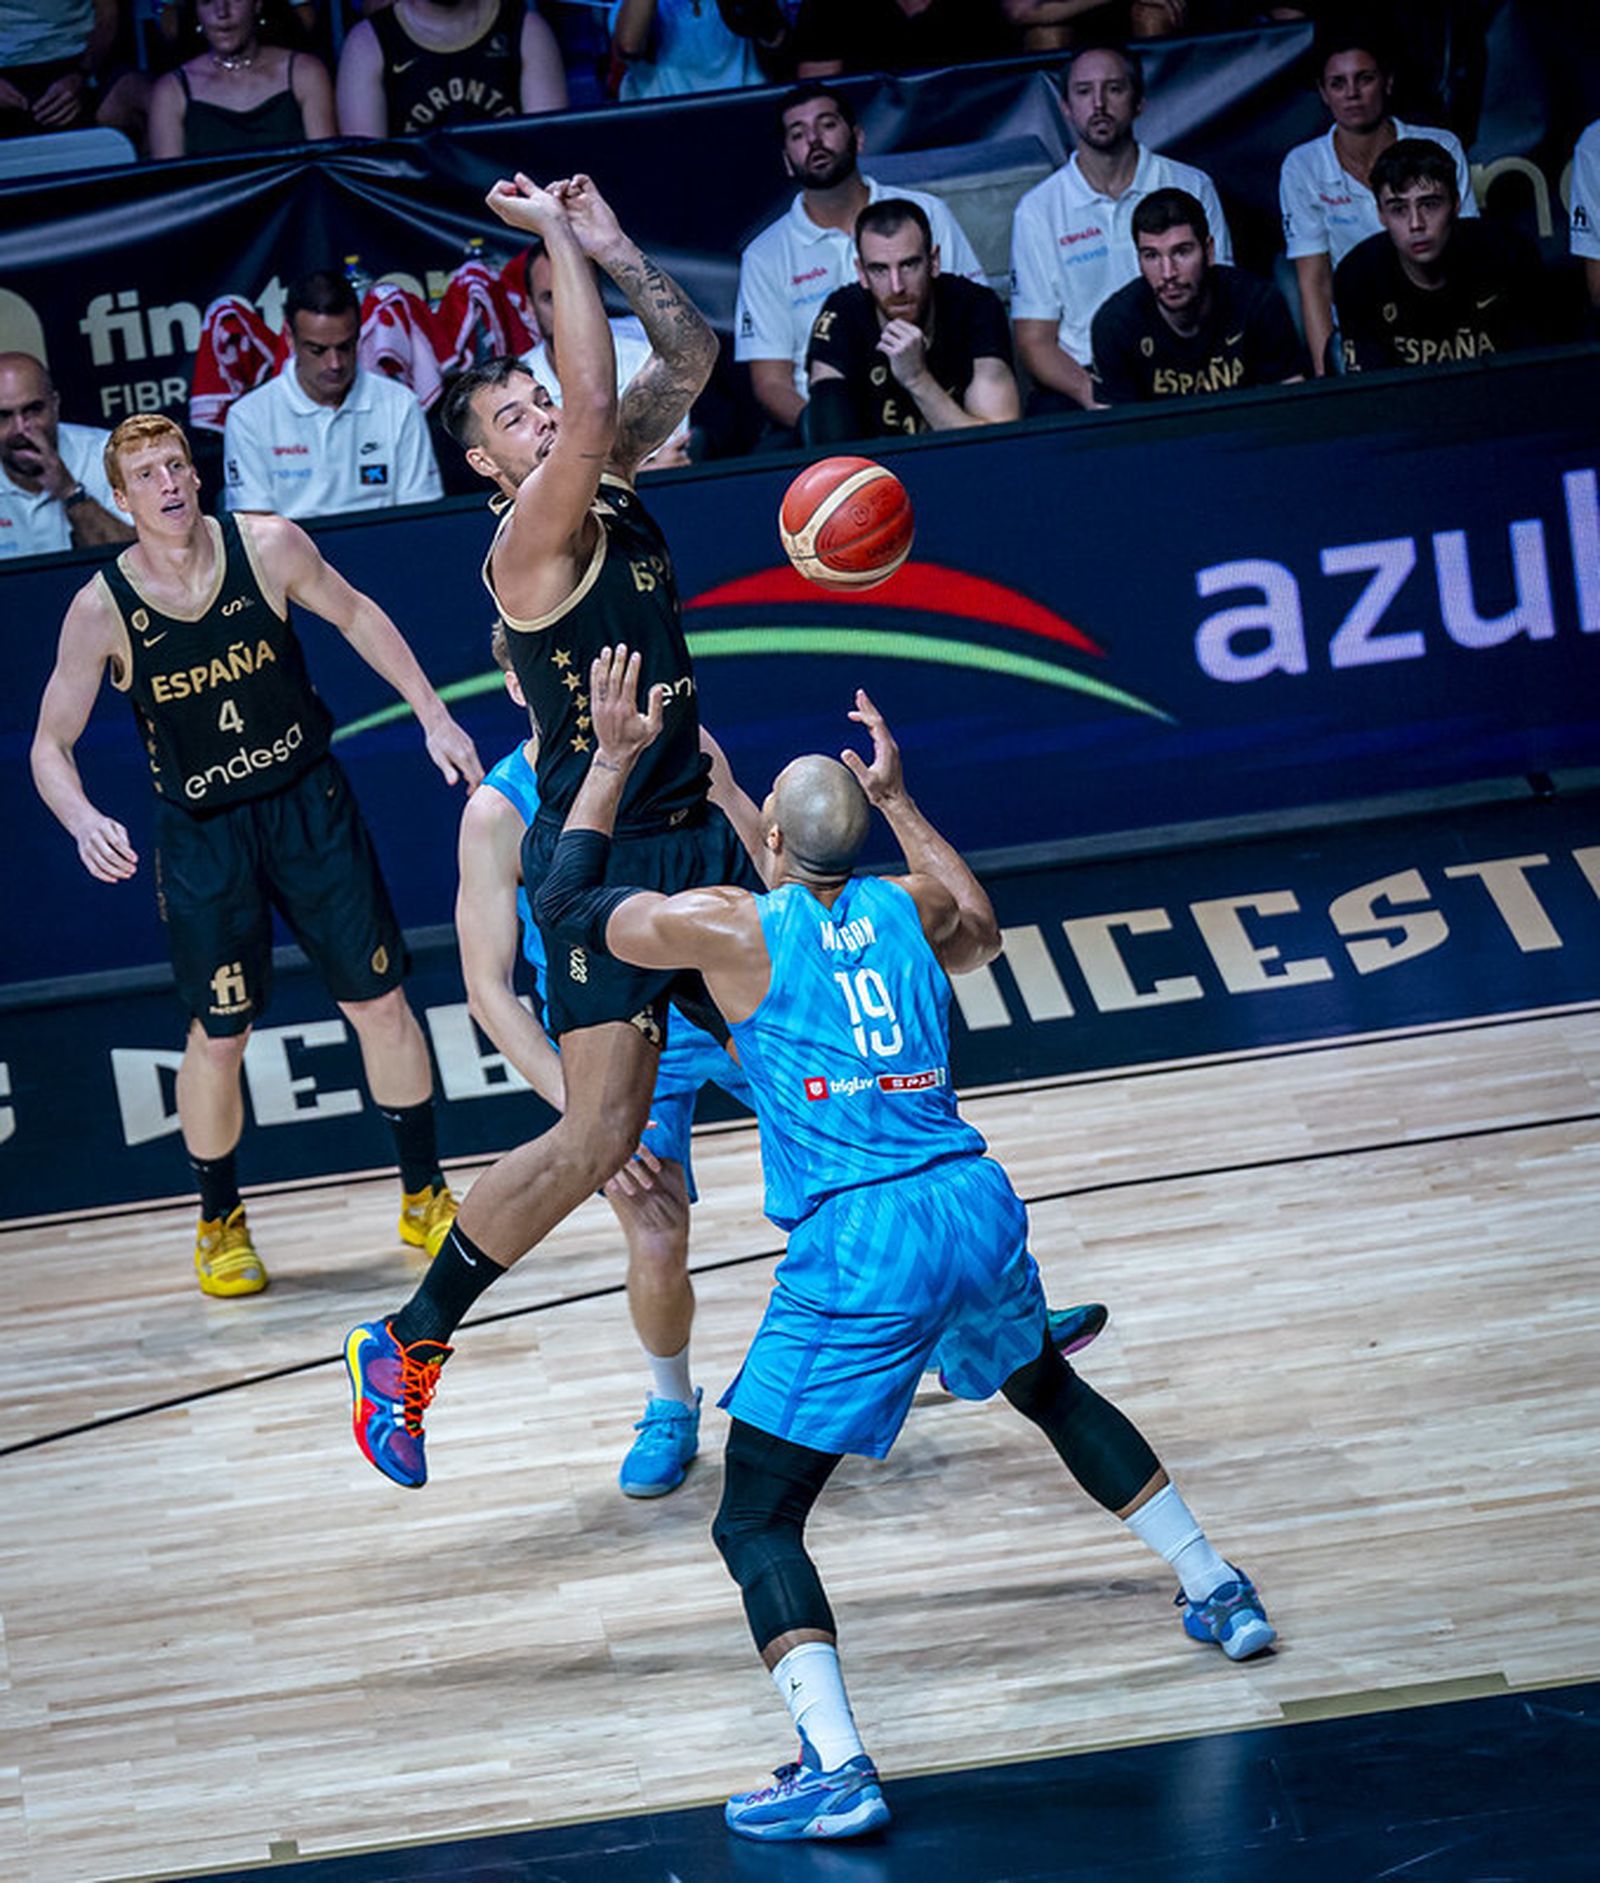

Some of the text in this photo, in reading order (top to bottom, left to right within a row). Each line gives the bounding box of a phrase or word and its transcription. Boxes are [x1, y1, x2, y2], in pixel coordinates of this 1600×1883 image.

[101, 376, 188, 418] FIBR
[1195, 468, 1600, 683] azul
[151, 640, 276, 704] ESPAÑA
[218, 700, 245, 734] 4
[185, 723, 304, 799] endesa
[833, 968, 904, 1058] 19
